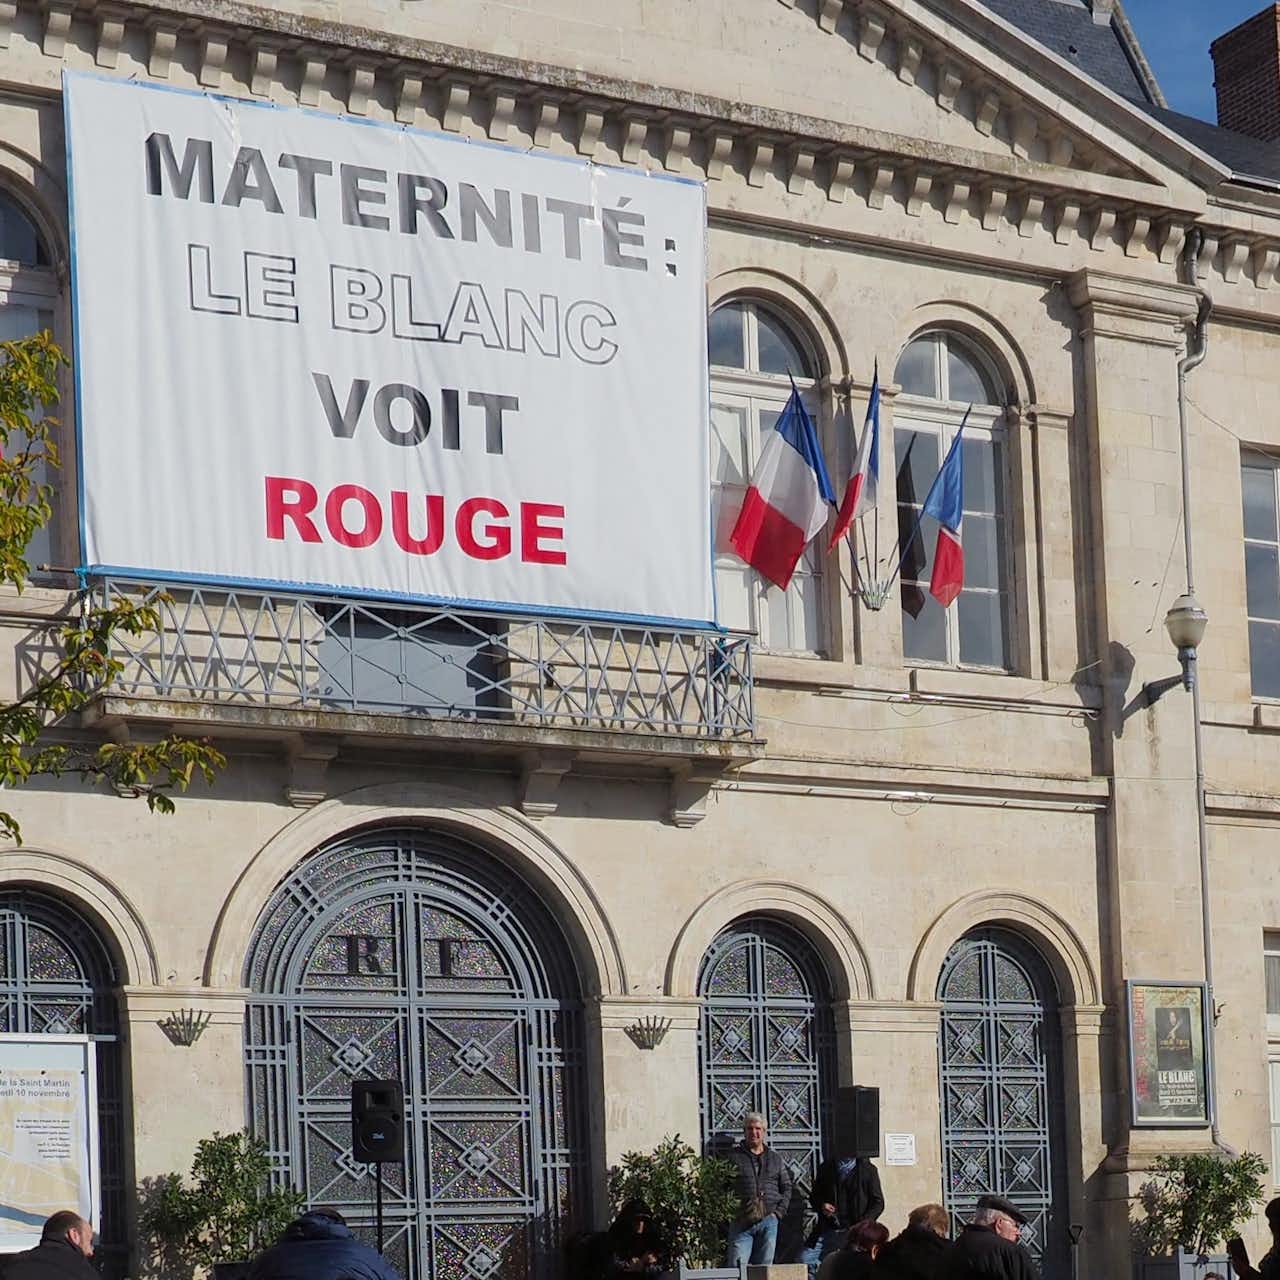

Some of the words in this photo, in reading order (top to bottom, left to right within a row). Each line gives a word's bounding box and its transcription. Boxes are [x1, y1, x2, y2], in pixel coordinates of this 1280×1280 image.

[187, 243, 299, 323] LE
[330, 263, 619, 365] BLANC
[311, 372, 520, 455] VOIT
[264, 475, 567, 566] ROUGE
[20, 1078, 42, 1088] Saint
[43, 1079, 71, 1088] Martin
[28, 1088, 71, 1098] novembre
